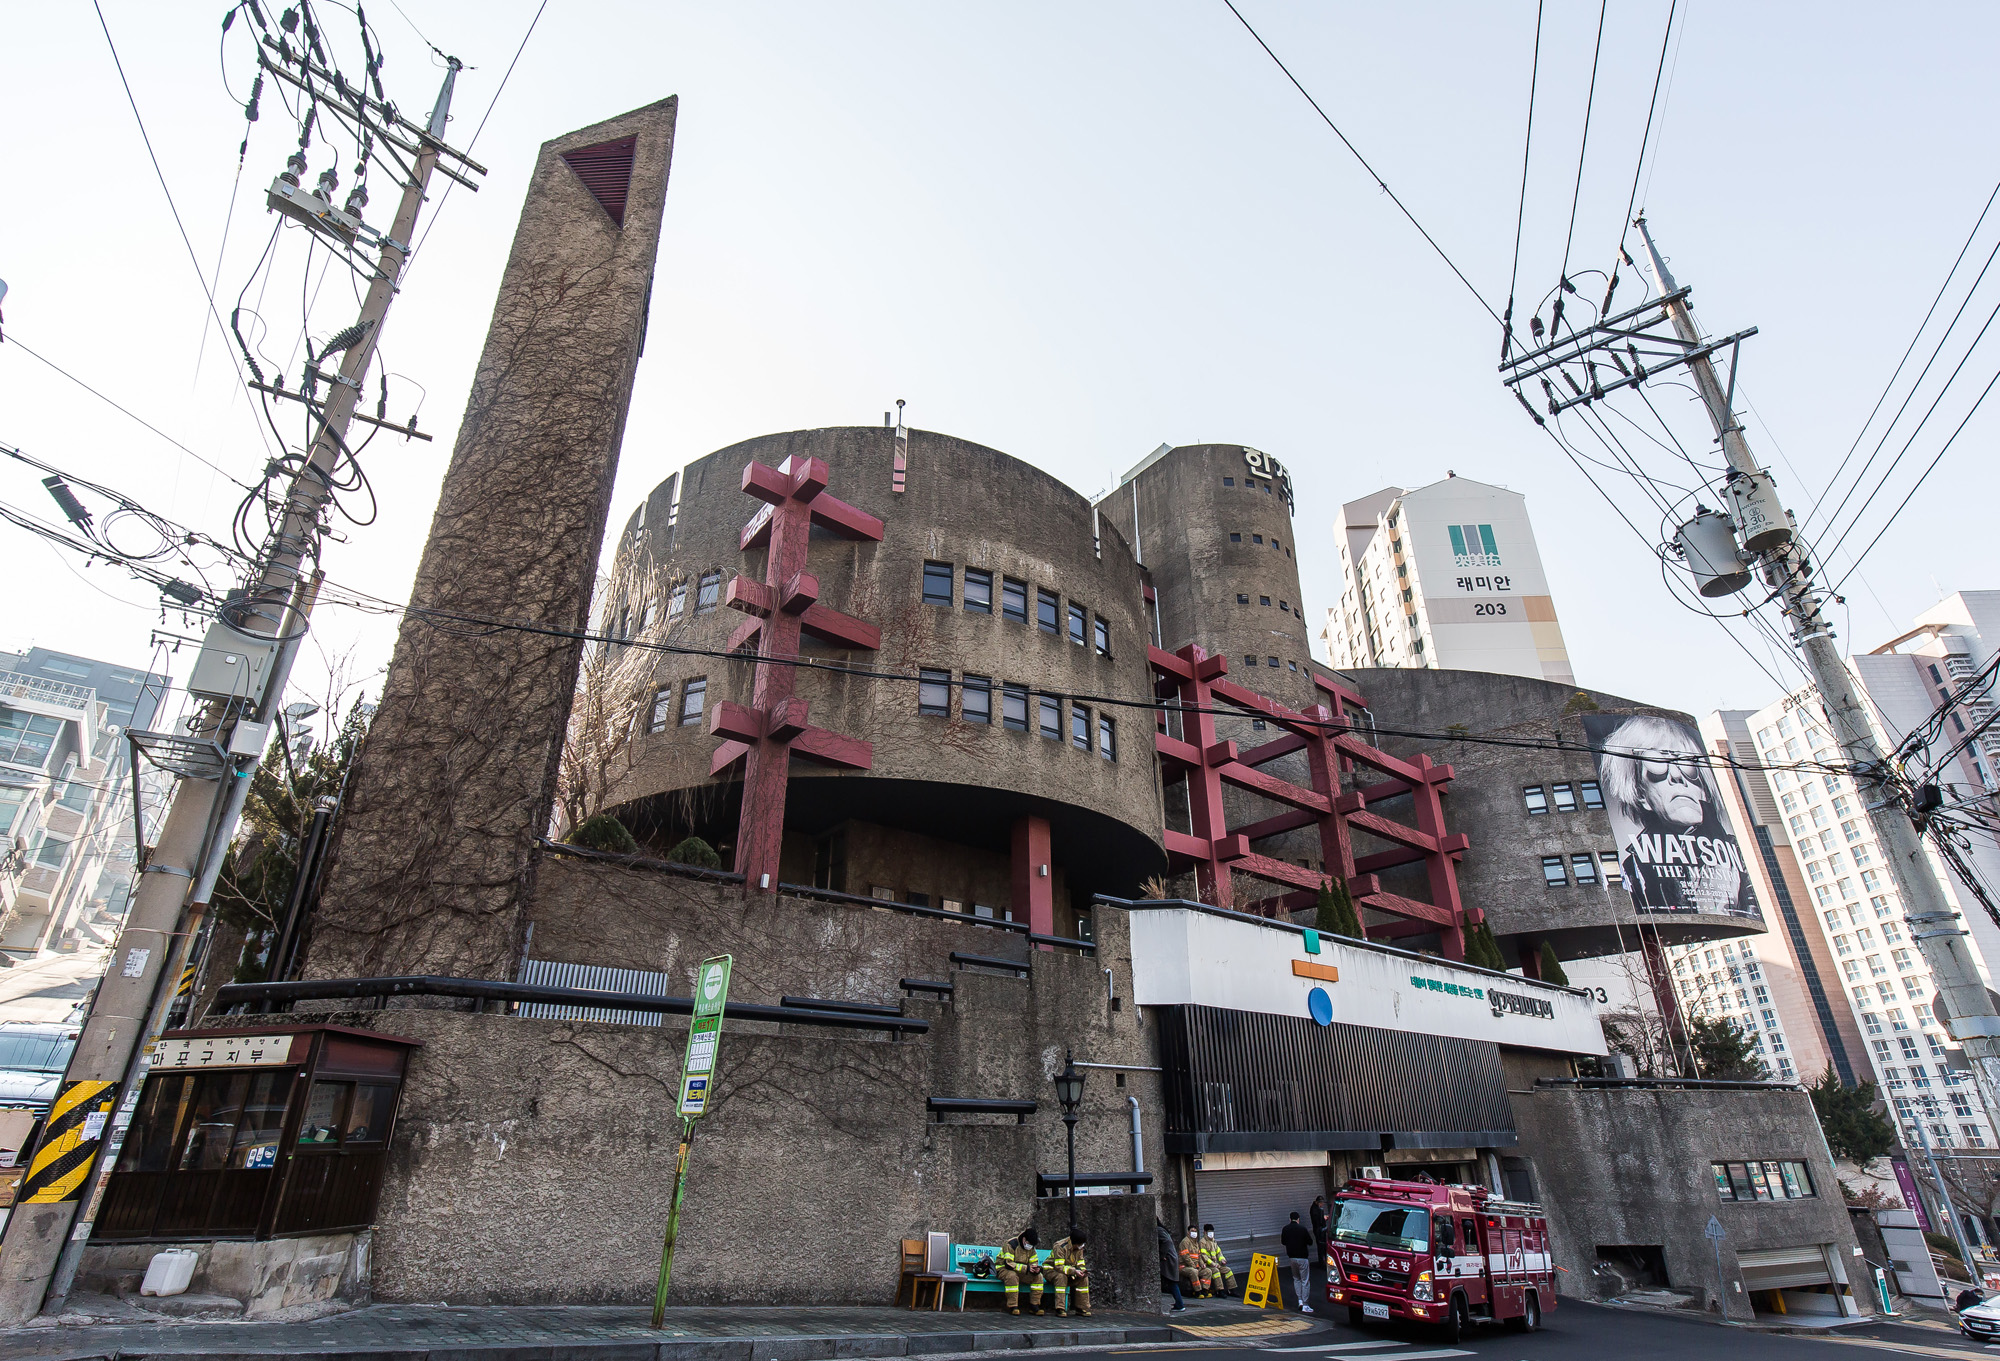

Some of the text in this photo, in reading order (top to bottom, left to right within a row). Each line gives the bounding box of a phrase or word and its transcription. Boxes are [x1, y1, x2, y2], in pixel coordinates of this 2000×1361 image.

[1750, 514, 1766, 527] 30
[1456, 575, 1511, 592] 래미안
[1474, 603, 1507, 616] 203
[1628, 833, 1744, 873] WATSON
[1652, 865, 1741, 883] THE MAESTRO
[1488, 988, 1555, 1020] 한겨레미디어
[151, 1049, 264, 1067] 마포구지부
[1341, 1251, 1411, 1272] 서울 소방
